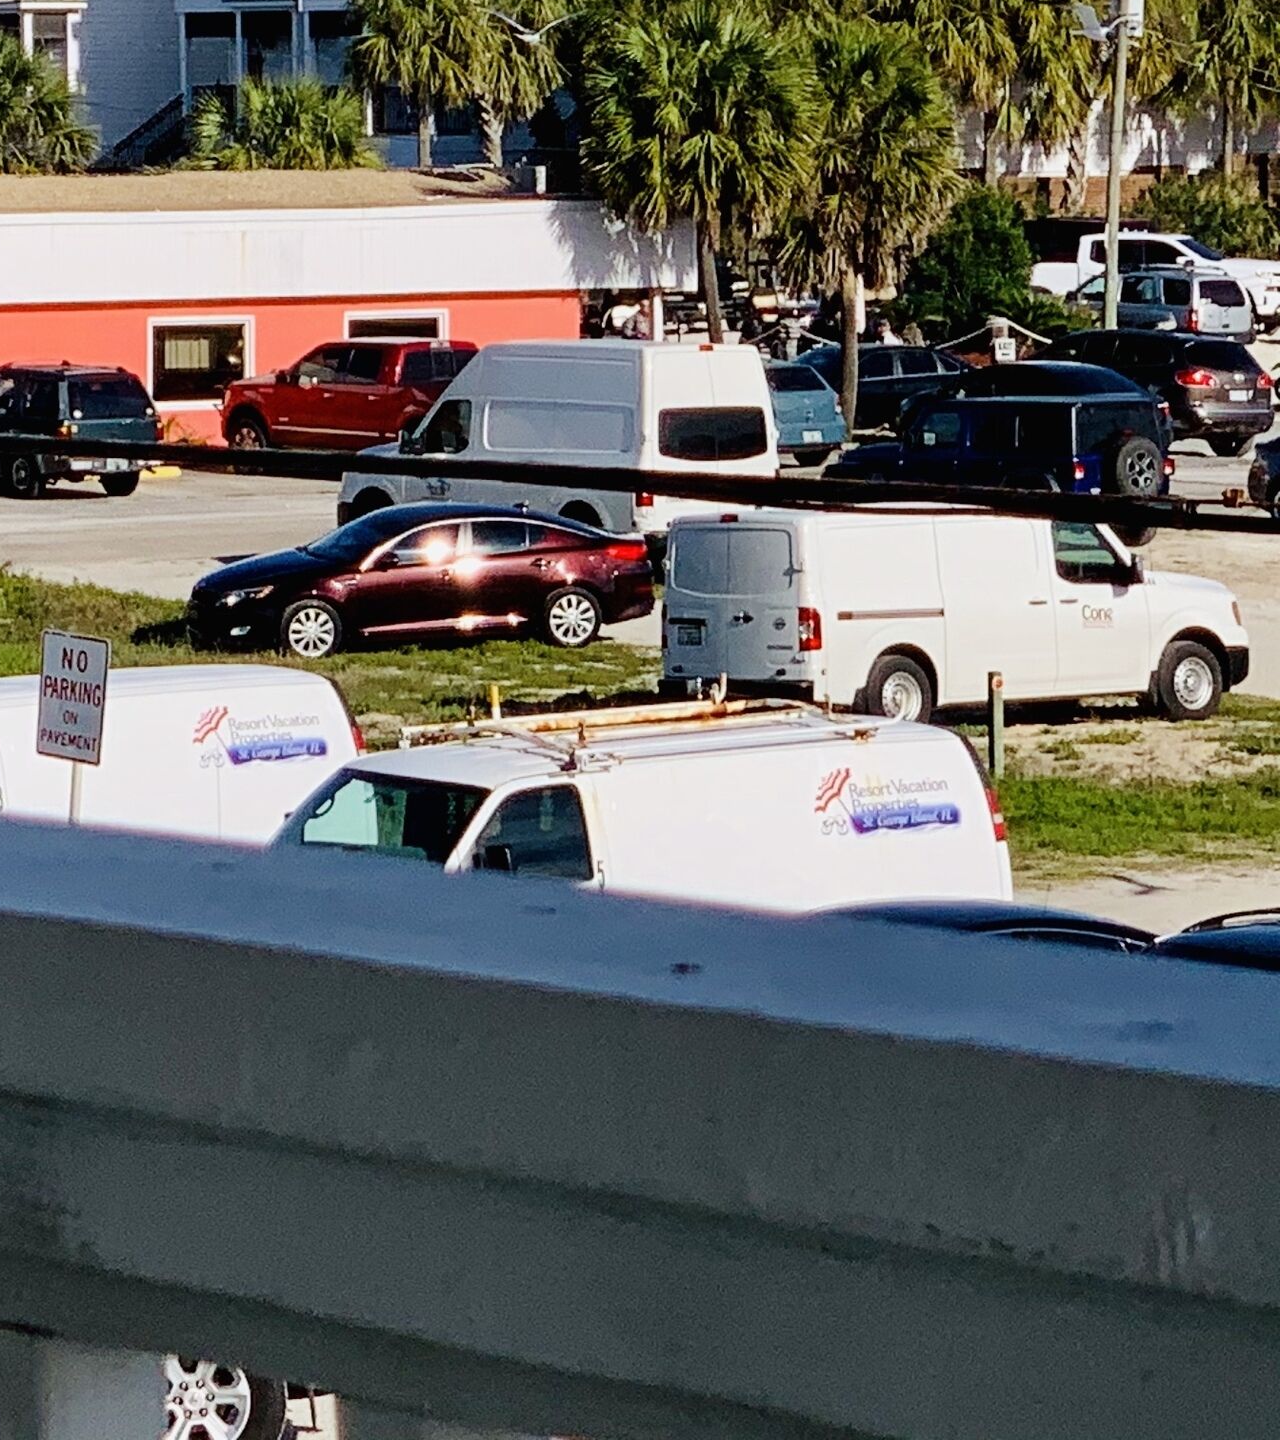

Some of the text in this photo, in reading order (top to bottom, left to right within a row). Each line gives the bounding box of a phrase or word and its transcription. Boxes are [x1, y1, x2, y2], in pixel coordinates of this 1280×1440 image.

[62, 647, 88, 673] NO
[43, 675, 102, 708] PARKING
[63, 710, 79, 725] ON
[228, 713, 320, 731] Resort Vacation
[40, 727, 97, 752] PAVEMENT
[231, 730, 294, 745] Properties
[849, 778, 949, 799] Resort Vacation
[851, 797, 920, 814] Properties
[597, 860, 605, 890] 5
